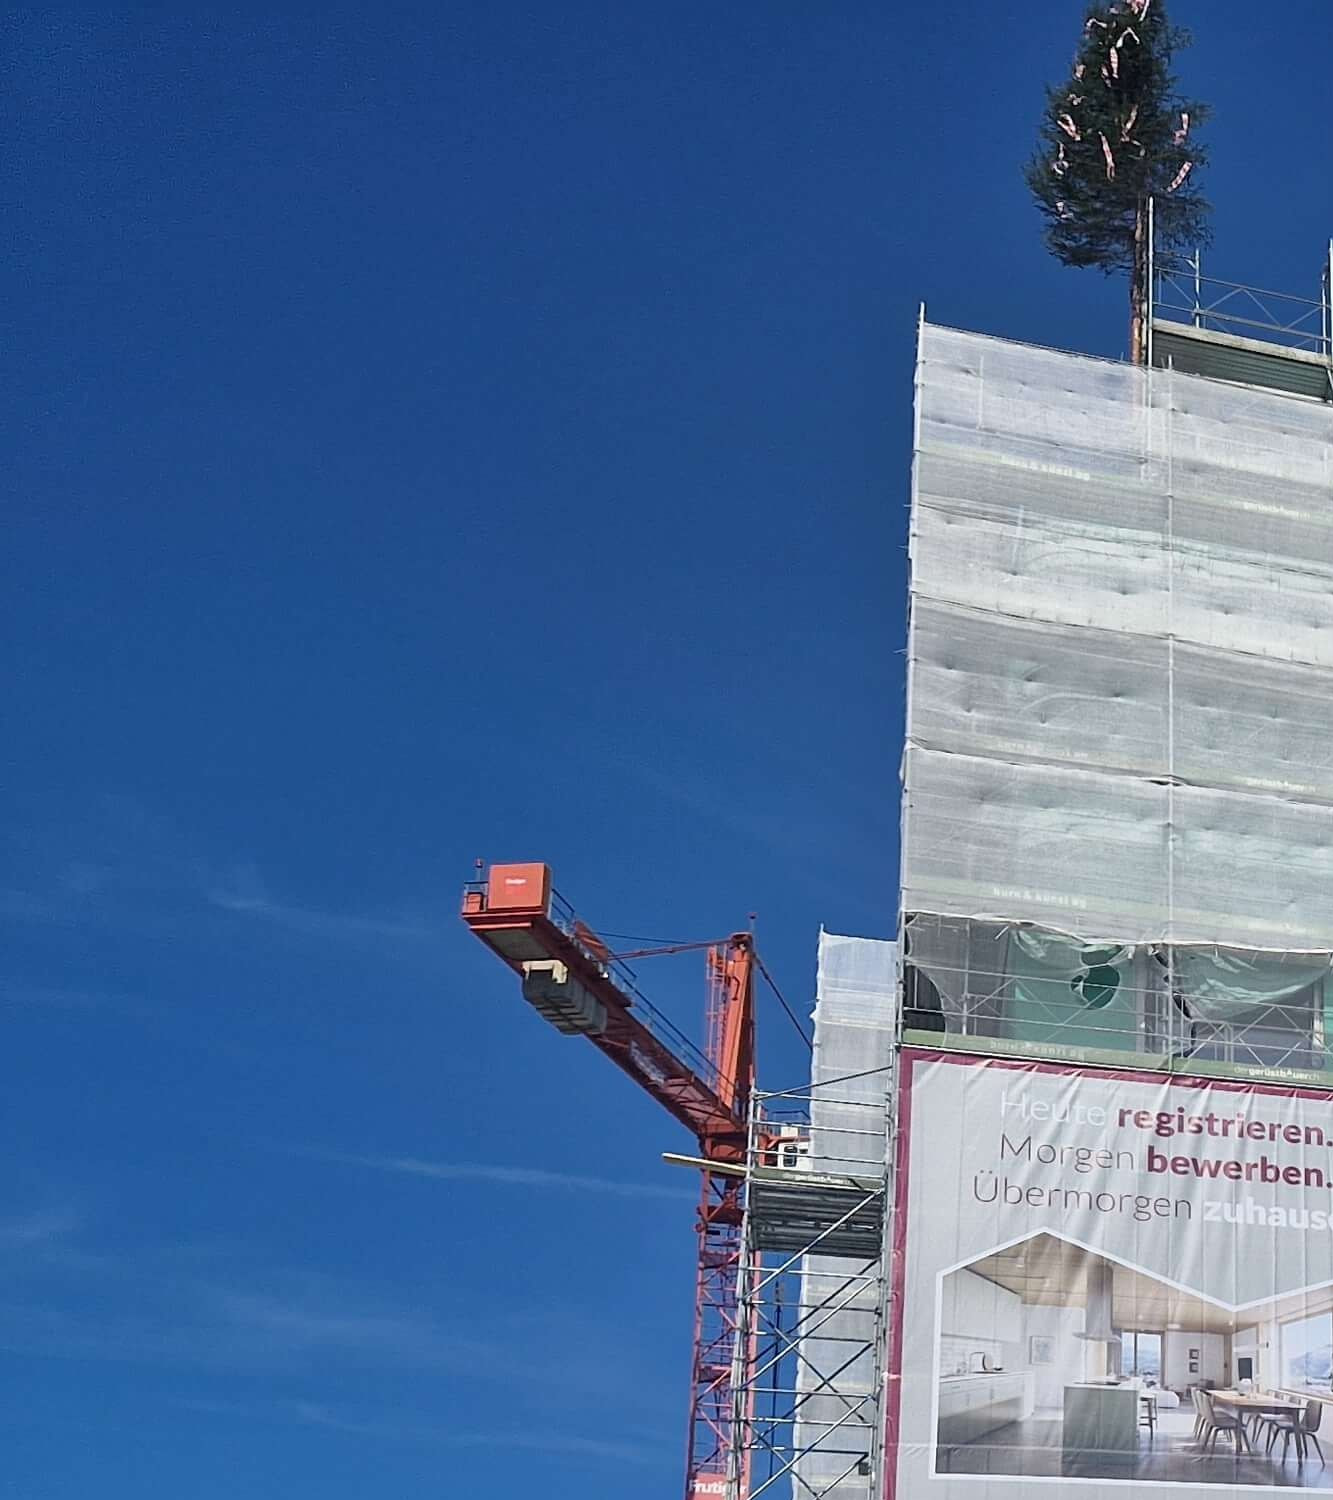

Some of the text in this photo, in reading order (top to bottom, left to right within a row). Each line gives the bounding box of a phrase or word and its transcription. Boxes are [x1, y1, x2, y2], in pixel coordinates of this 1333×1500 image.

[1000, 1092, 1333, 1147] Heute registrieren.
[1000, 1134, 1333, 1188] Morgen bewerben.
[973, 1169, 1192, 1221] Übermorgen
